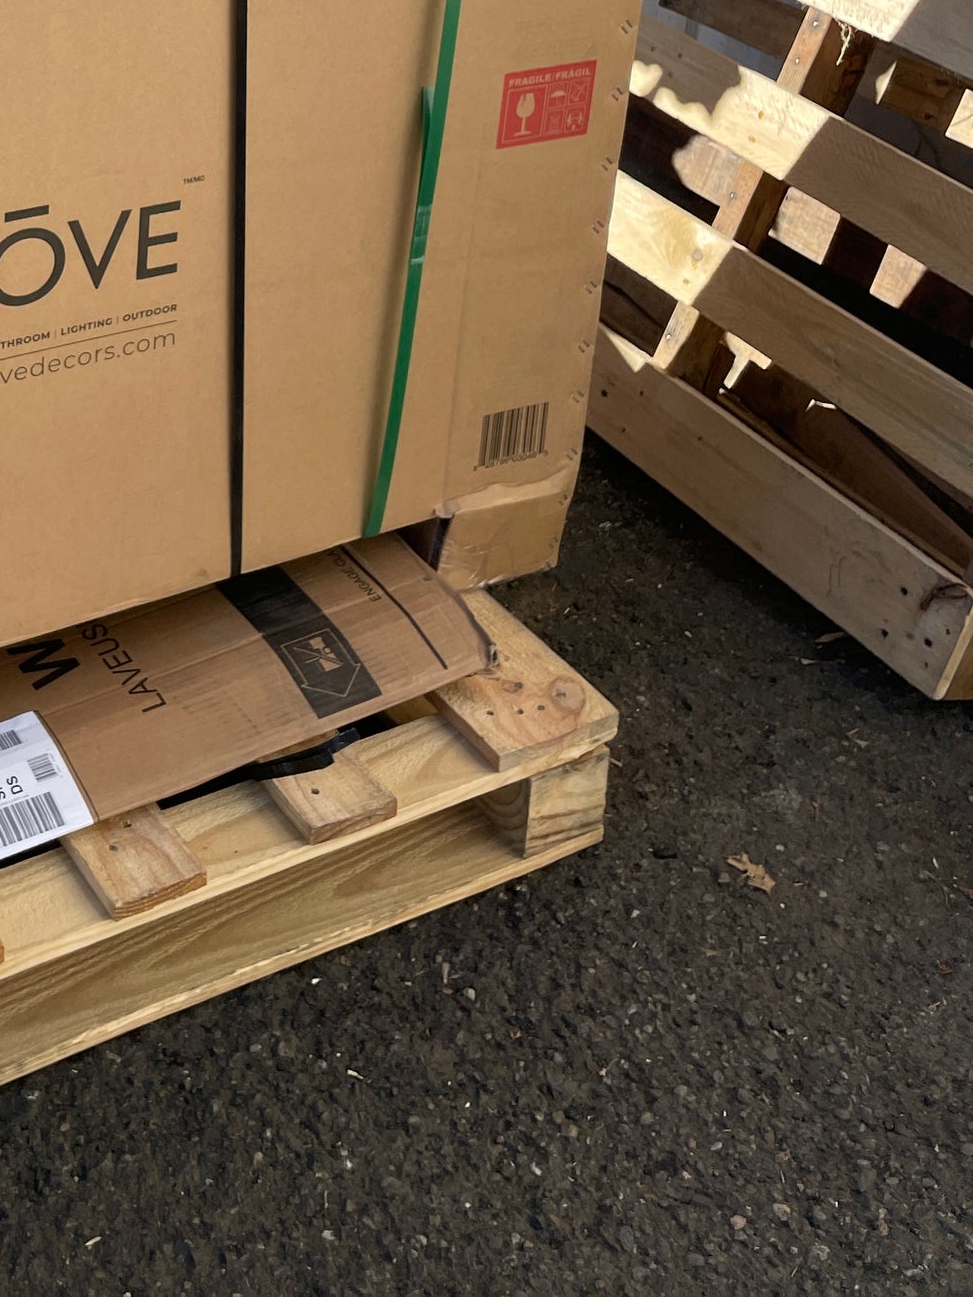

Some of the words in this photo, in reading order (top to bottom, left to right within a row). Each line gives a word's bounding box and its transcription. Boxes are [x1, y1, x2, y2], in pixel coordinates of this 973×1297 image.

[60, 317, 113, 336] LIGHTING
[122, 304, 177, 322] OUTDOOR
[79, 620, 166, 713] LAVEUS
[7, 776, 23, 795] DS
